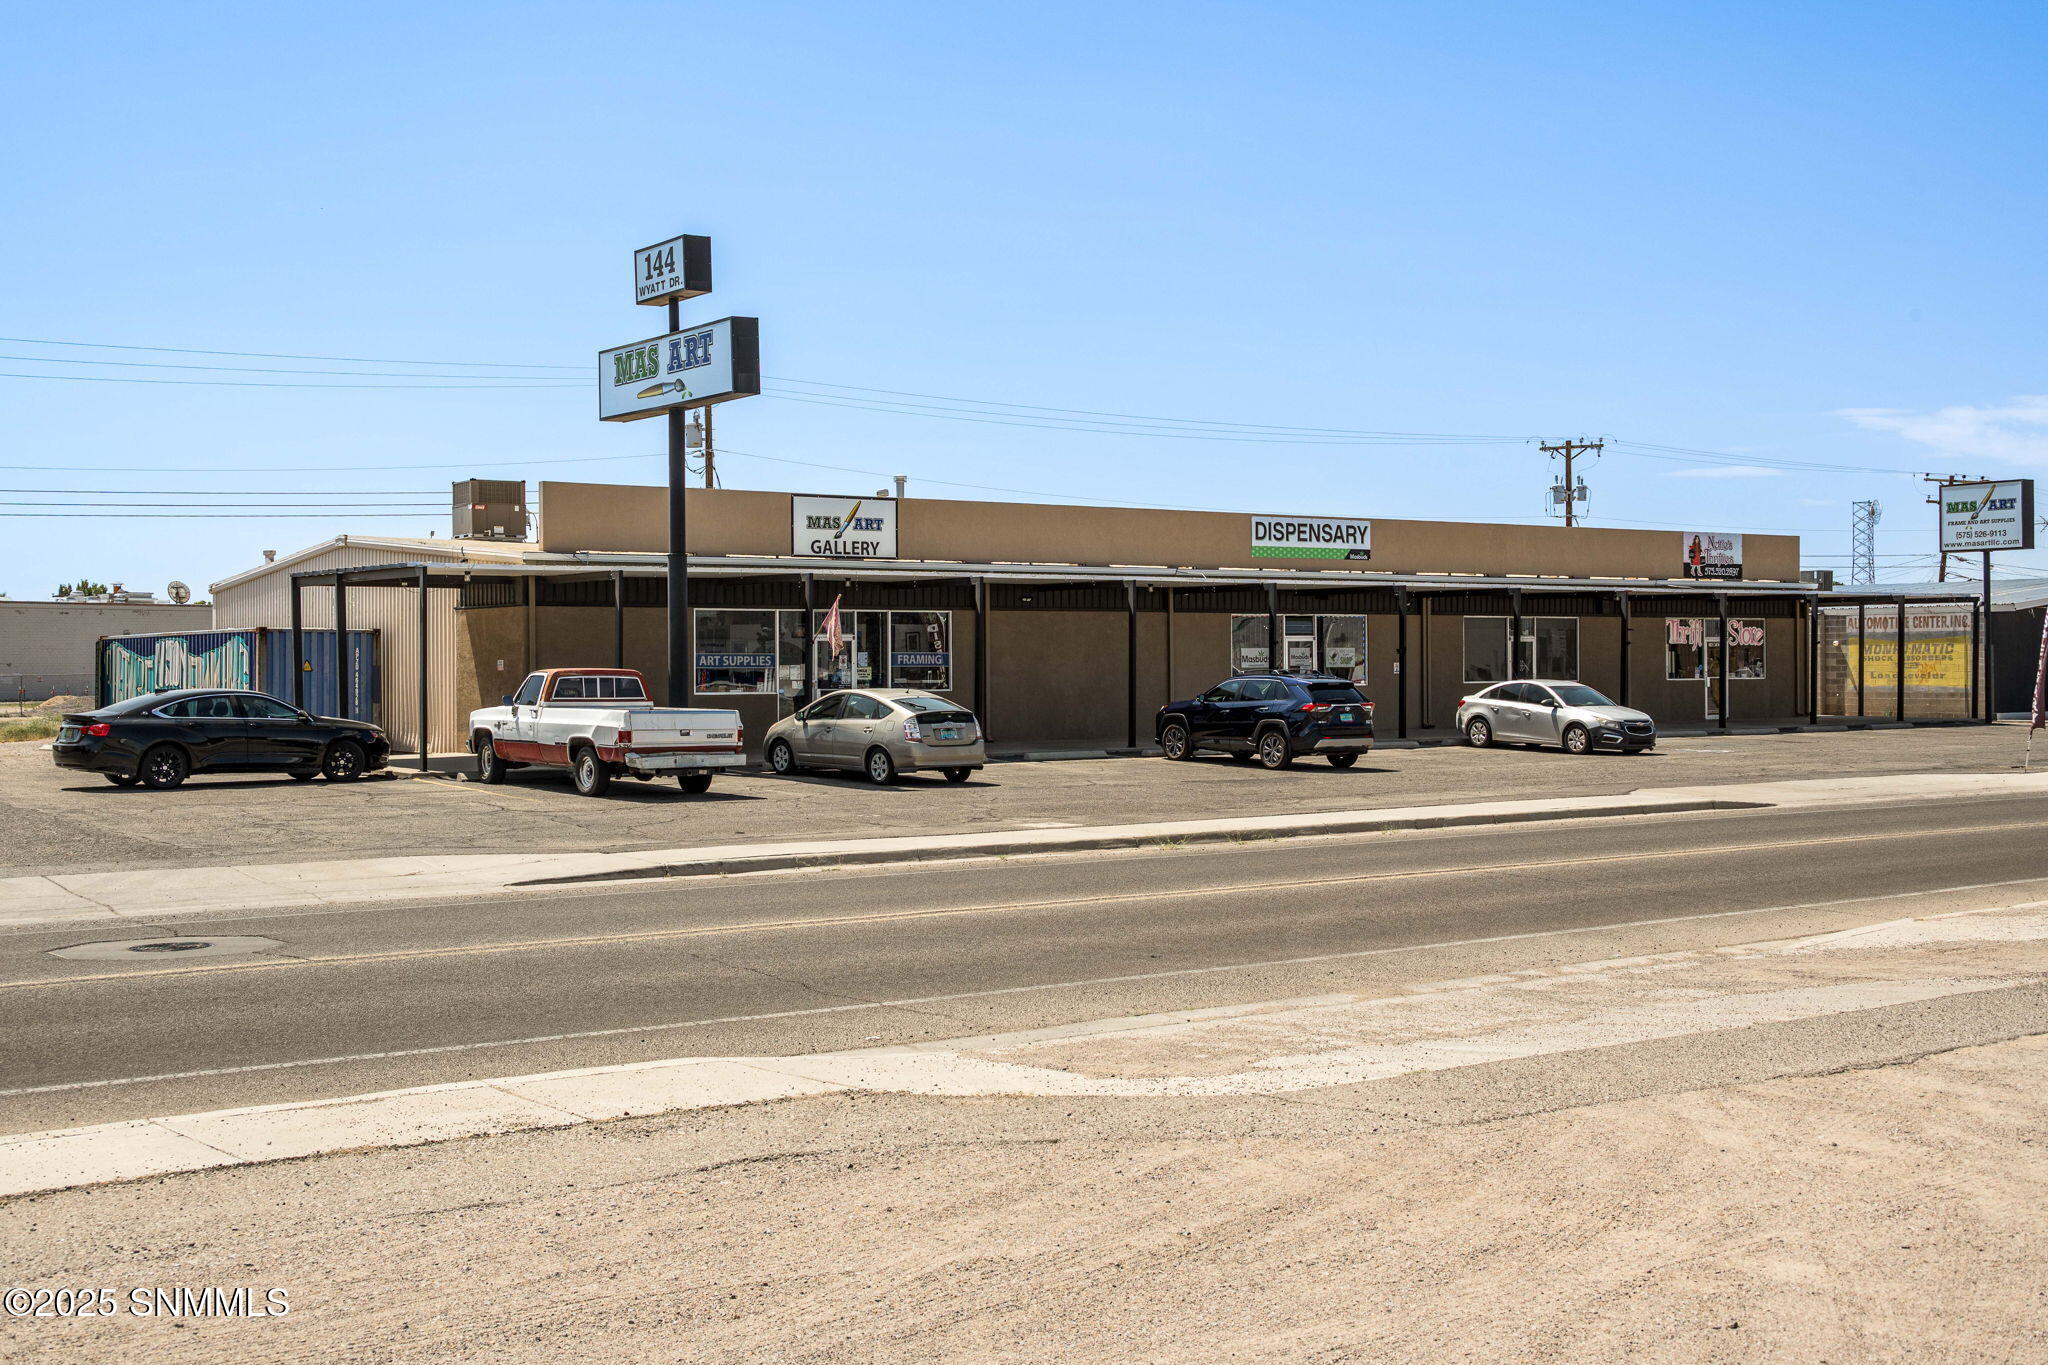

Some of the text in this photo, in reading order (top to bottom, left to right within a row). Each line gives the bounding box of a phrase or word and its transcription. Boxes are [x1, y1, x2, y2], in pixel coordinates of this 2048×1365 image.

[645, 246, 676, 281] 144
[639, 276, 683, 297] WYATT DR.
[614, 330, 713, 387] MAS ART
[1946, 498, 2017, 513] MAS ART
[806, 515, 884, 531] MAS ART
[1255, 521, 1369, 544] DISPENSARY
[1955, 529, 2007, 540] (575) 526-9113
[810, 540, 880, 556] GALLERY
[1943, 538, 2020, 549] www.masartllc.com
[1848, 616, 1910, 630] AUOMOTIE
[1666, 619, 1764, 652] Thrift Store
[699, 655, 771, 666] ART SUPPLIES
[898, 655, 943, 665] FRAMING
